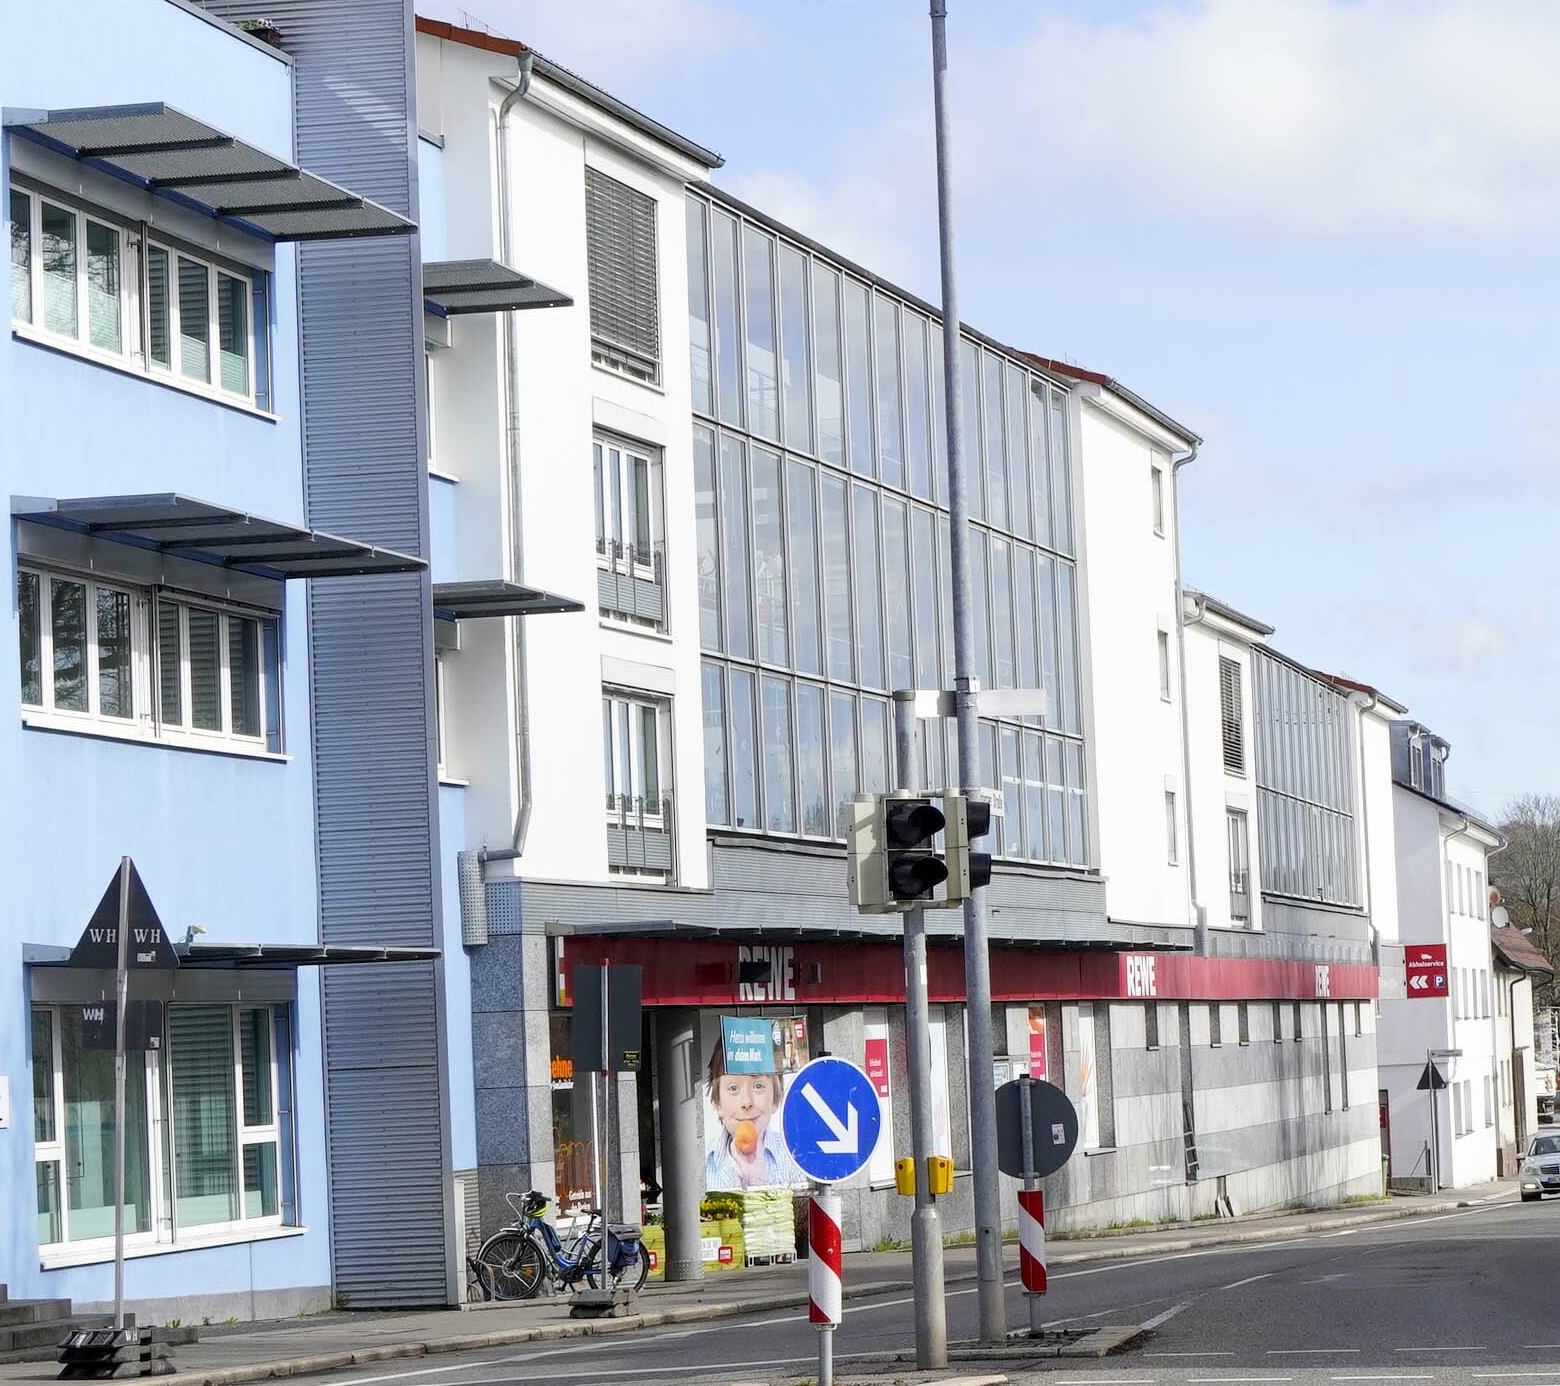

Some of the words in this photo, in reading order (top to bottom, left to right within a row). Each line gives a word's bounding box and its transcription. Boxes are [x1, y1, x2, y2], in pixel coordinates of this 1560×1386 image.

[90, 928, 117, 943] WH
[134, 928, 161, 943] WH
[1409, 960, 1444, 968] Abholservice
[739, 946, 795, 1001] REWE
[1126, 956, 1157, 997] REWE
